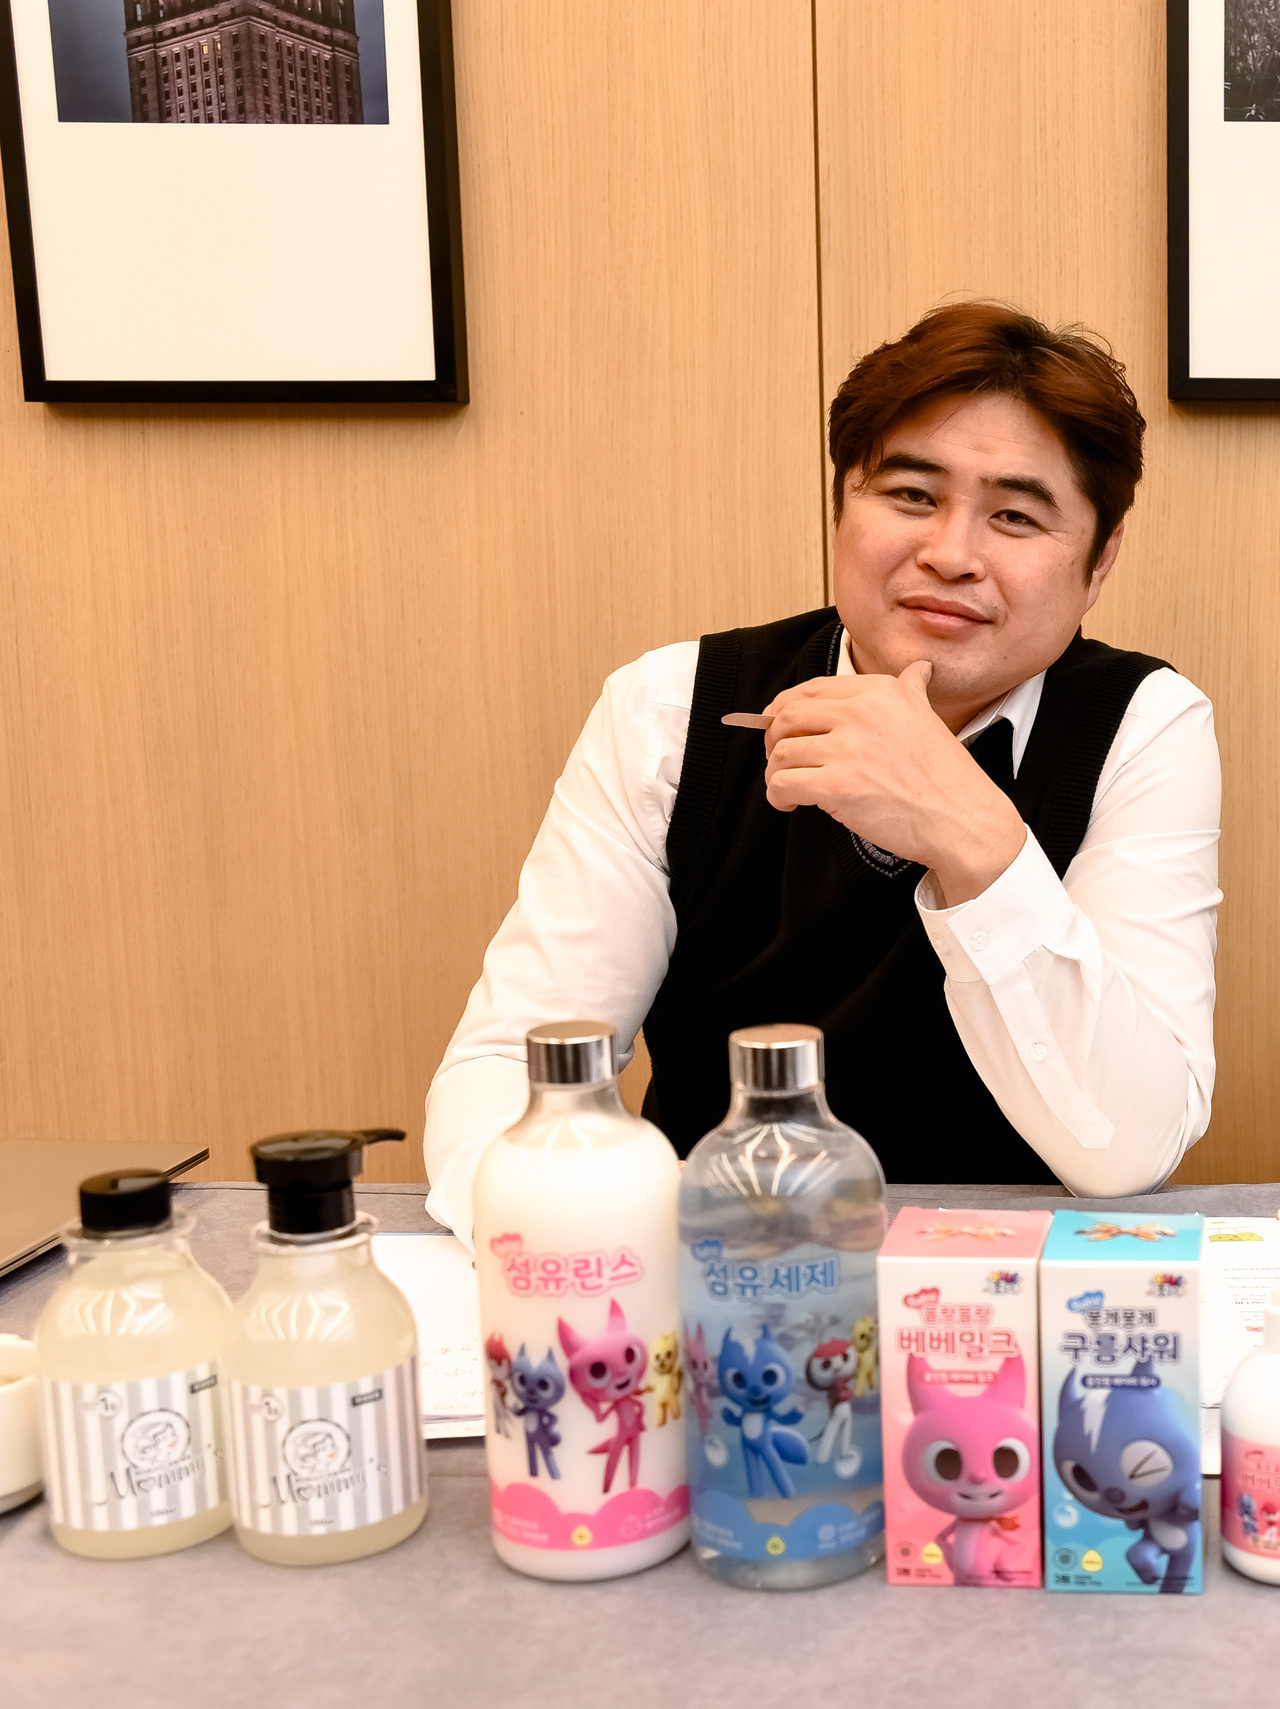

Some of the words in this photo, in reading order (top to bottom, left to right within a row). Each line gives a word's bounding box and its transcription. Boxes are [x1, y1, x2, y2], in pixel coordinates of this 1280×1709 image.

[506, 1252, 639, 1292] 섬유린스
[706, 1260, 835, 1297] 섬유세제
[899, 1330, 1017, 1359] 베베밀크
[1062, 1332, 1179, 1363] 구름샤워
